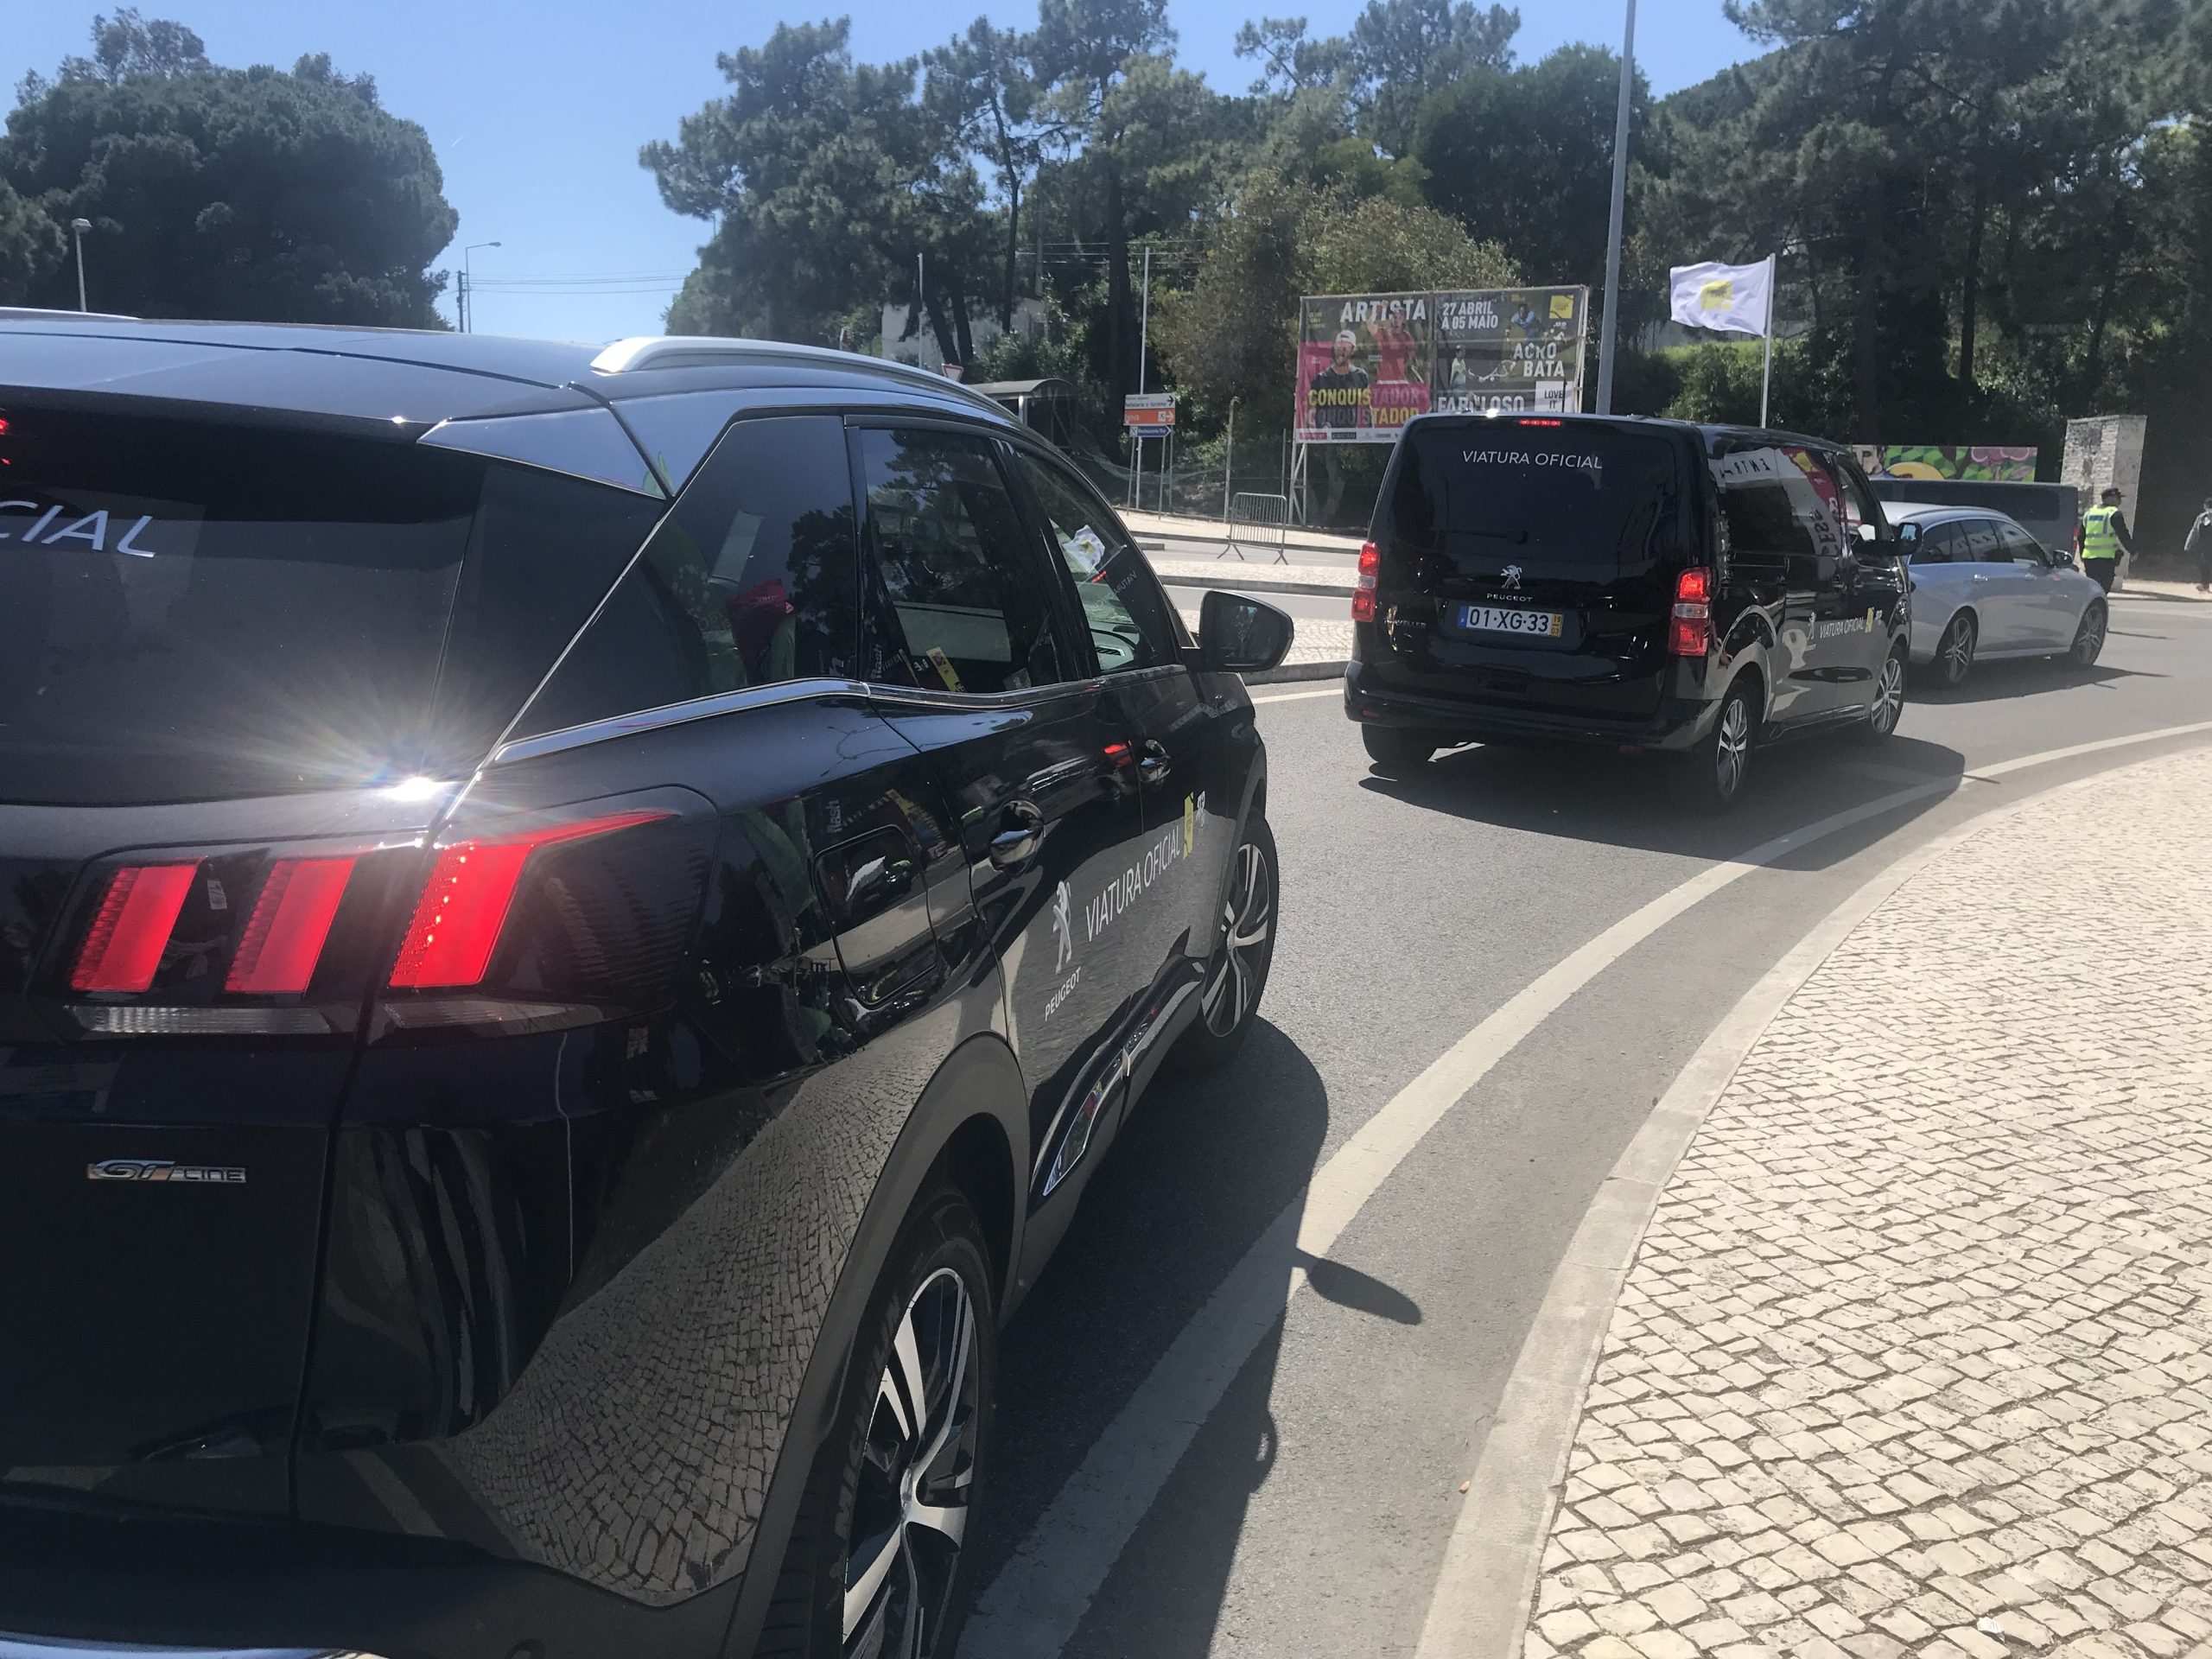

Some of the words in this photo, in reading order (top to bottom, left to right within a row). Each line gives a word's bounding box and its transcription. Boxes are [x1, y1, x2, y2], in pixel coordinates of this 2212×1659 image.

[1339, 298, 1427, 323] ARTISTA
[1442, 302, 1457, 316] 27
[1458, 301, 1493, 315] ABRIL
[1440, 316, 1450, 330] A
[1452, 316, 1466, 330] 05
[1467, 315, 1499, 329] MAIO
[1522, 360, 1565, 378] BATA
[1462, 450, 1530, 465] VIATURA
[1535, 453, 1603, 469] OFICIAL
[1486, 593, 1533, 602] PEUGEOT
[1819, 621, 1844, 639] VIATURA
[1843, 616, 1865, 634] OFICIAL
[1085, 862, 1141, 942] VIATURA
[1143, 825, 1181, 887] OFICIAL
[1045, 966, 1081, 1021] PEUGEOT
